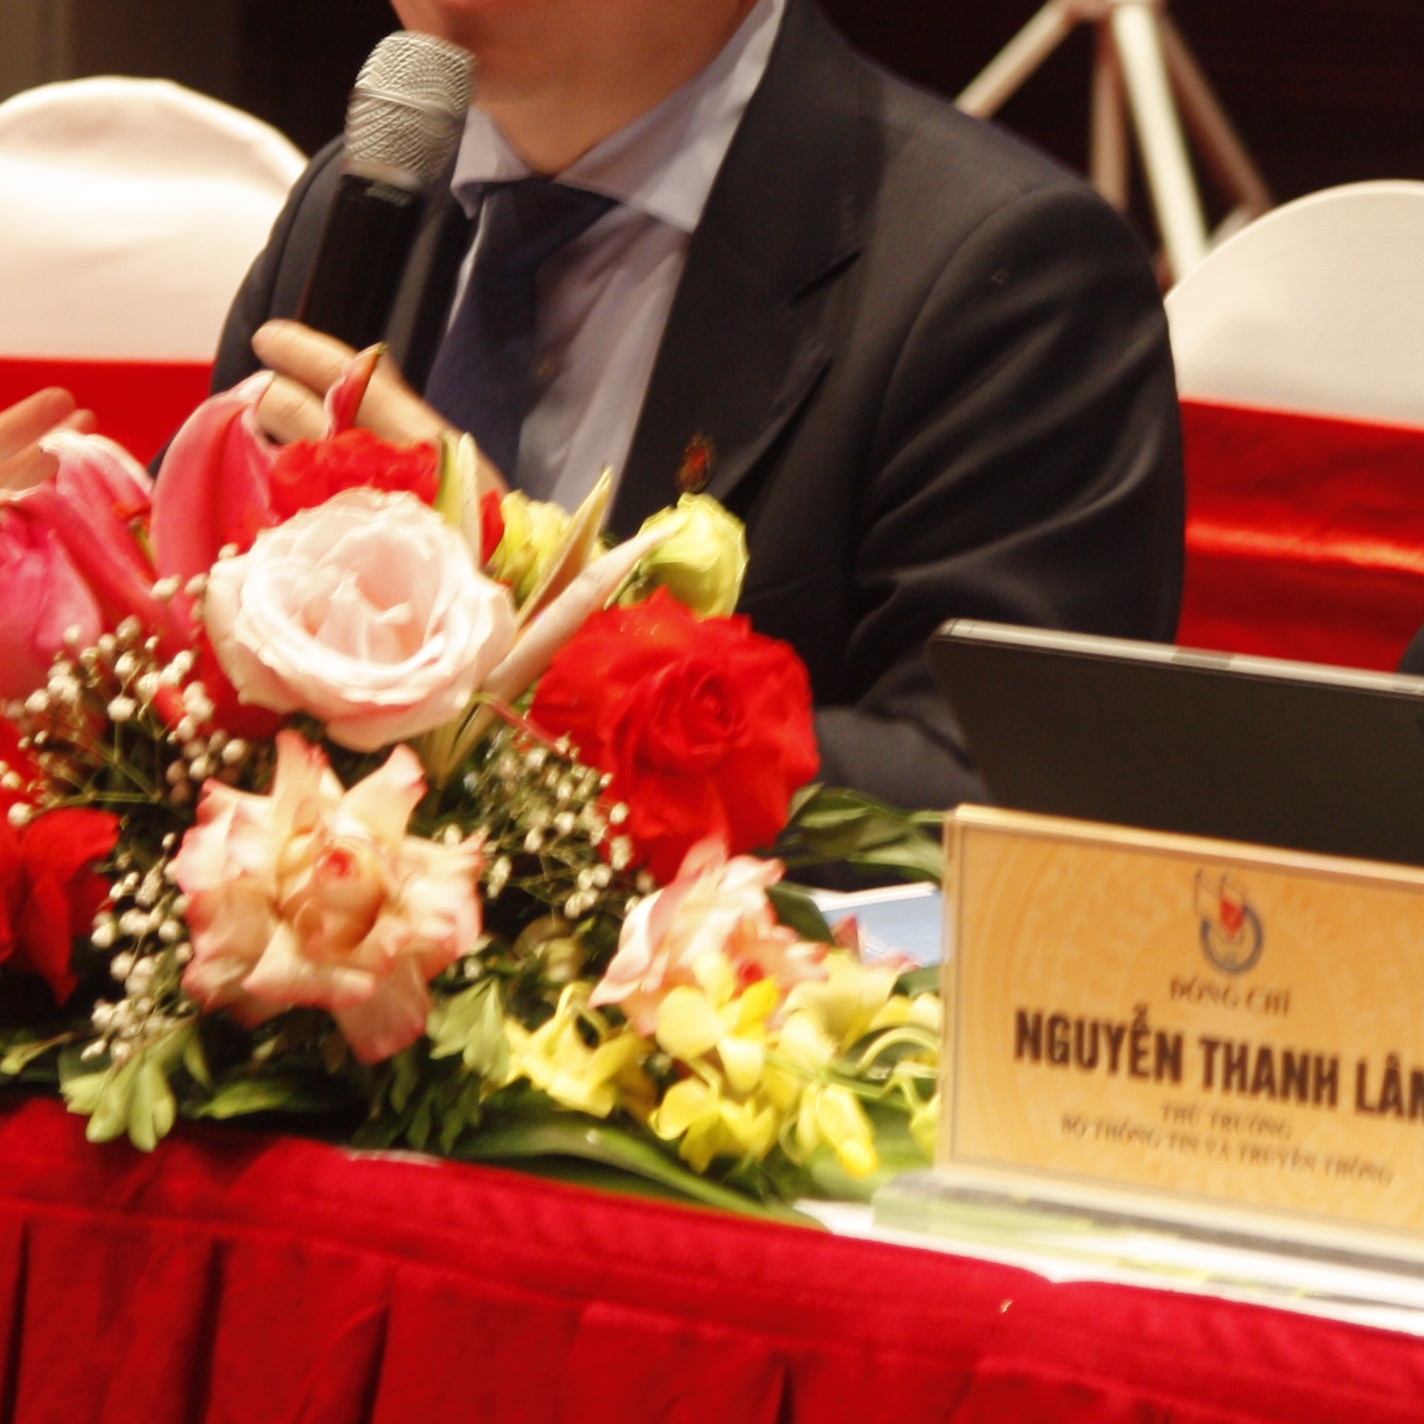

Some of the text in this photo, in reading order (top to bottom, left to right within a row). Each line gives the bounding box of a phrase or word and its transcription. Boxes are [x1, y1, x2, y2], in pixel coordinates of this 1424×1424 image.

[1245, 984, 1292, 1018] CHÍ
[1013, 1002, 1184, 1087] NGUYỄN
[1198, 1035, 1340, 1111] THANH
